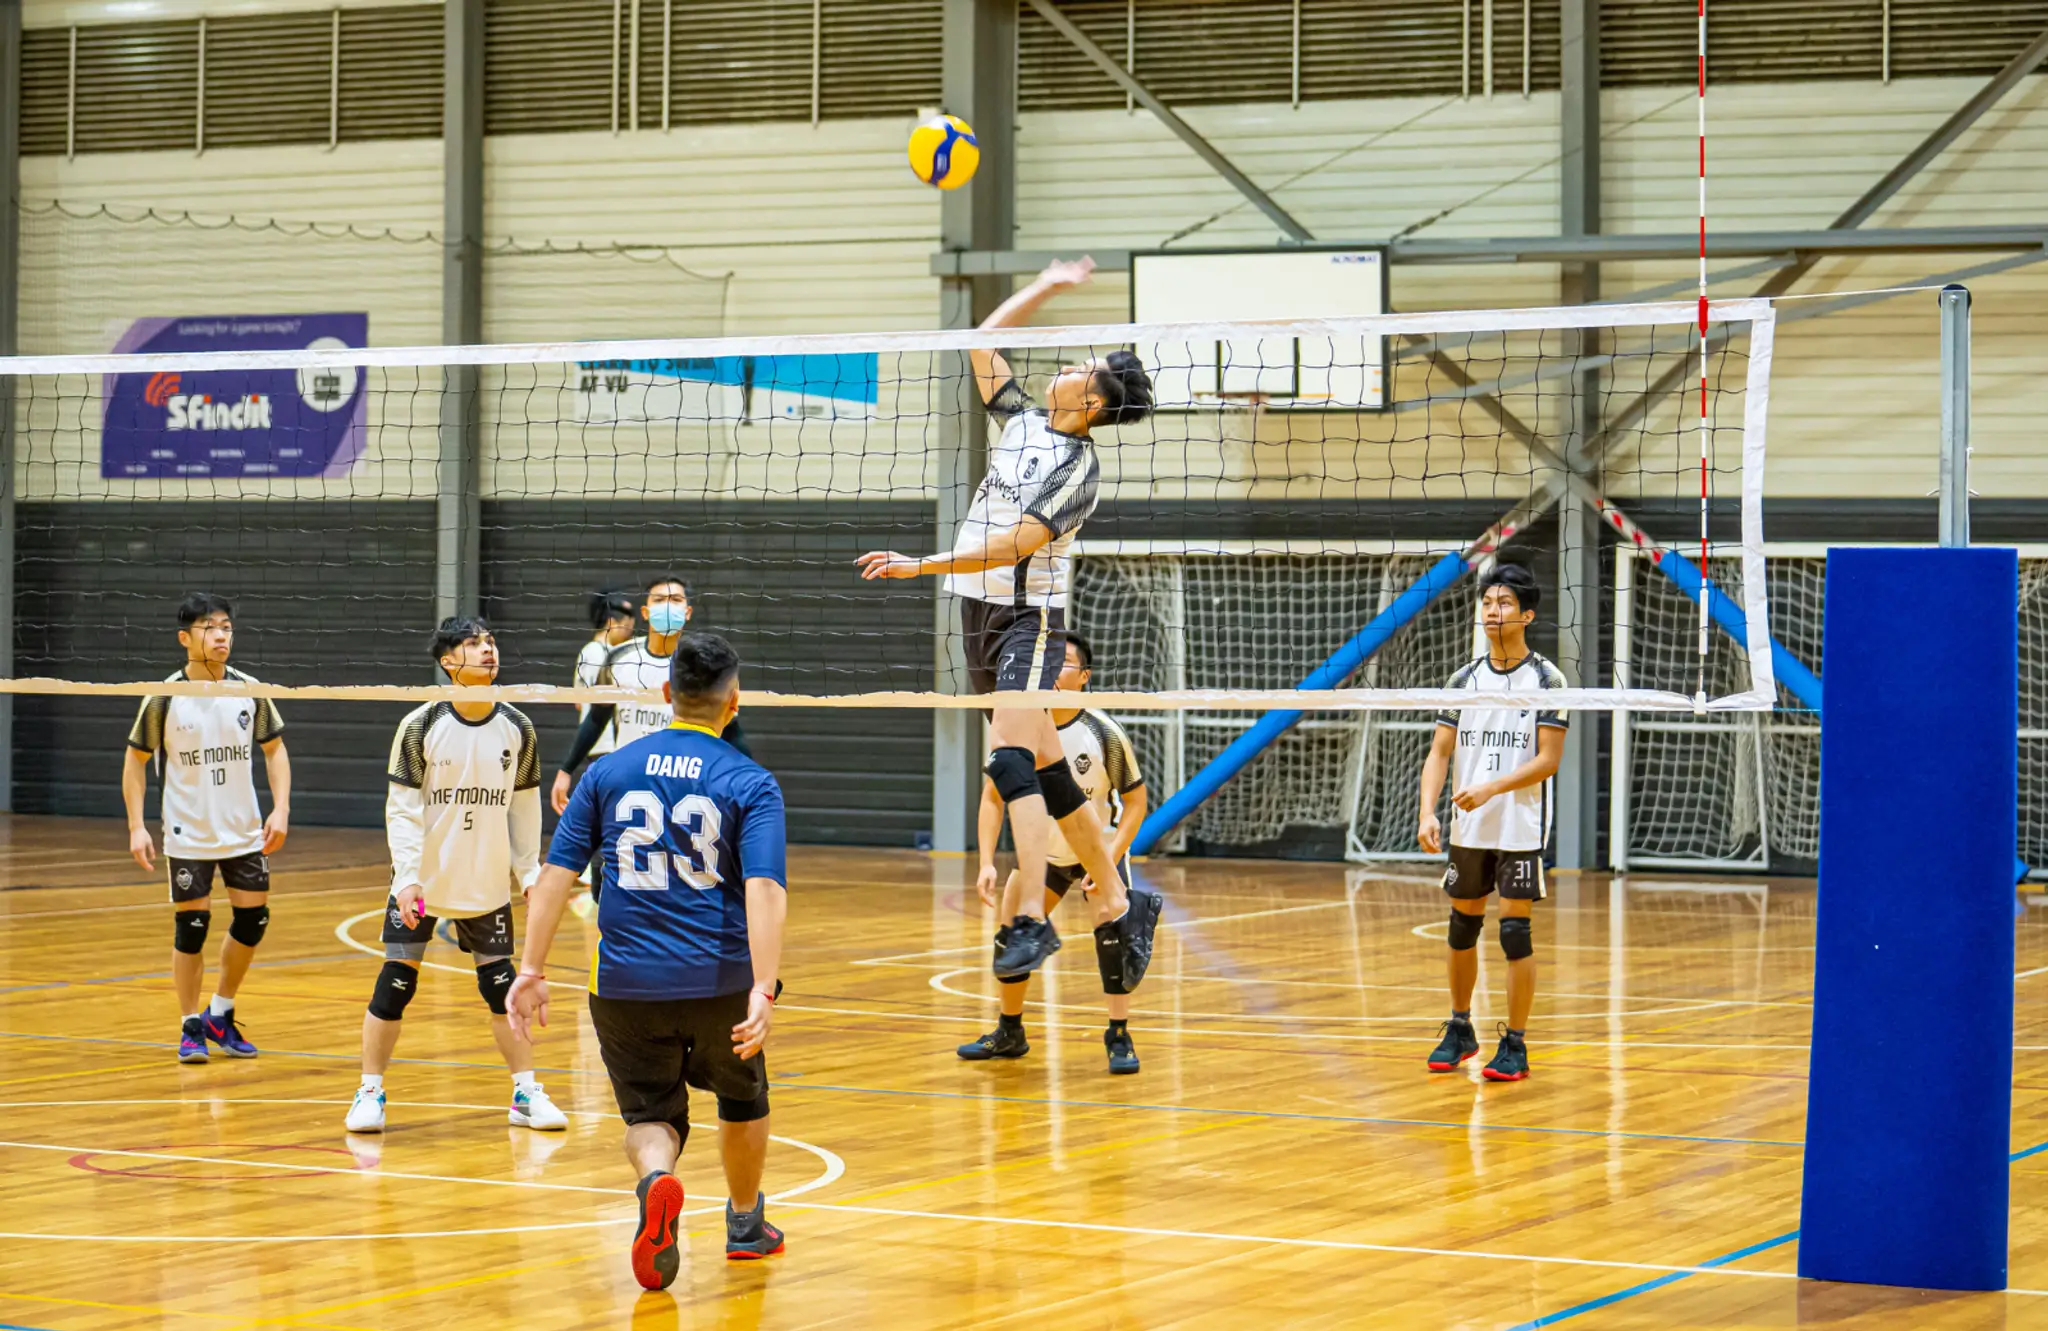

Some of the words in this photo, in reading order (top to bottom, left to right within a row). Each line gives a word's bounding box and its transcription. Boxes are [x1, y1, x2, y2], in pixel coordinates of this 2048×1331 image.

[580, 375, 598, 393] AT
[605, 375, 628, 393] VU
[1004, 652, 1016, 671] 7
[1460, 730, 1476, 747] ME
[179, 749, 201, 767] ME
[645, 753, 703, 780] DANG
[211, 768, 226, 786] 10
[428, 788, 453, 806] ME
[463, 811, 473, 830] 5
[615, 790, 724, 890] 23
[1514, 860, 1531, 880] 31
[495, 914, 506, 934] 5
